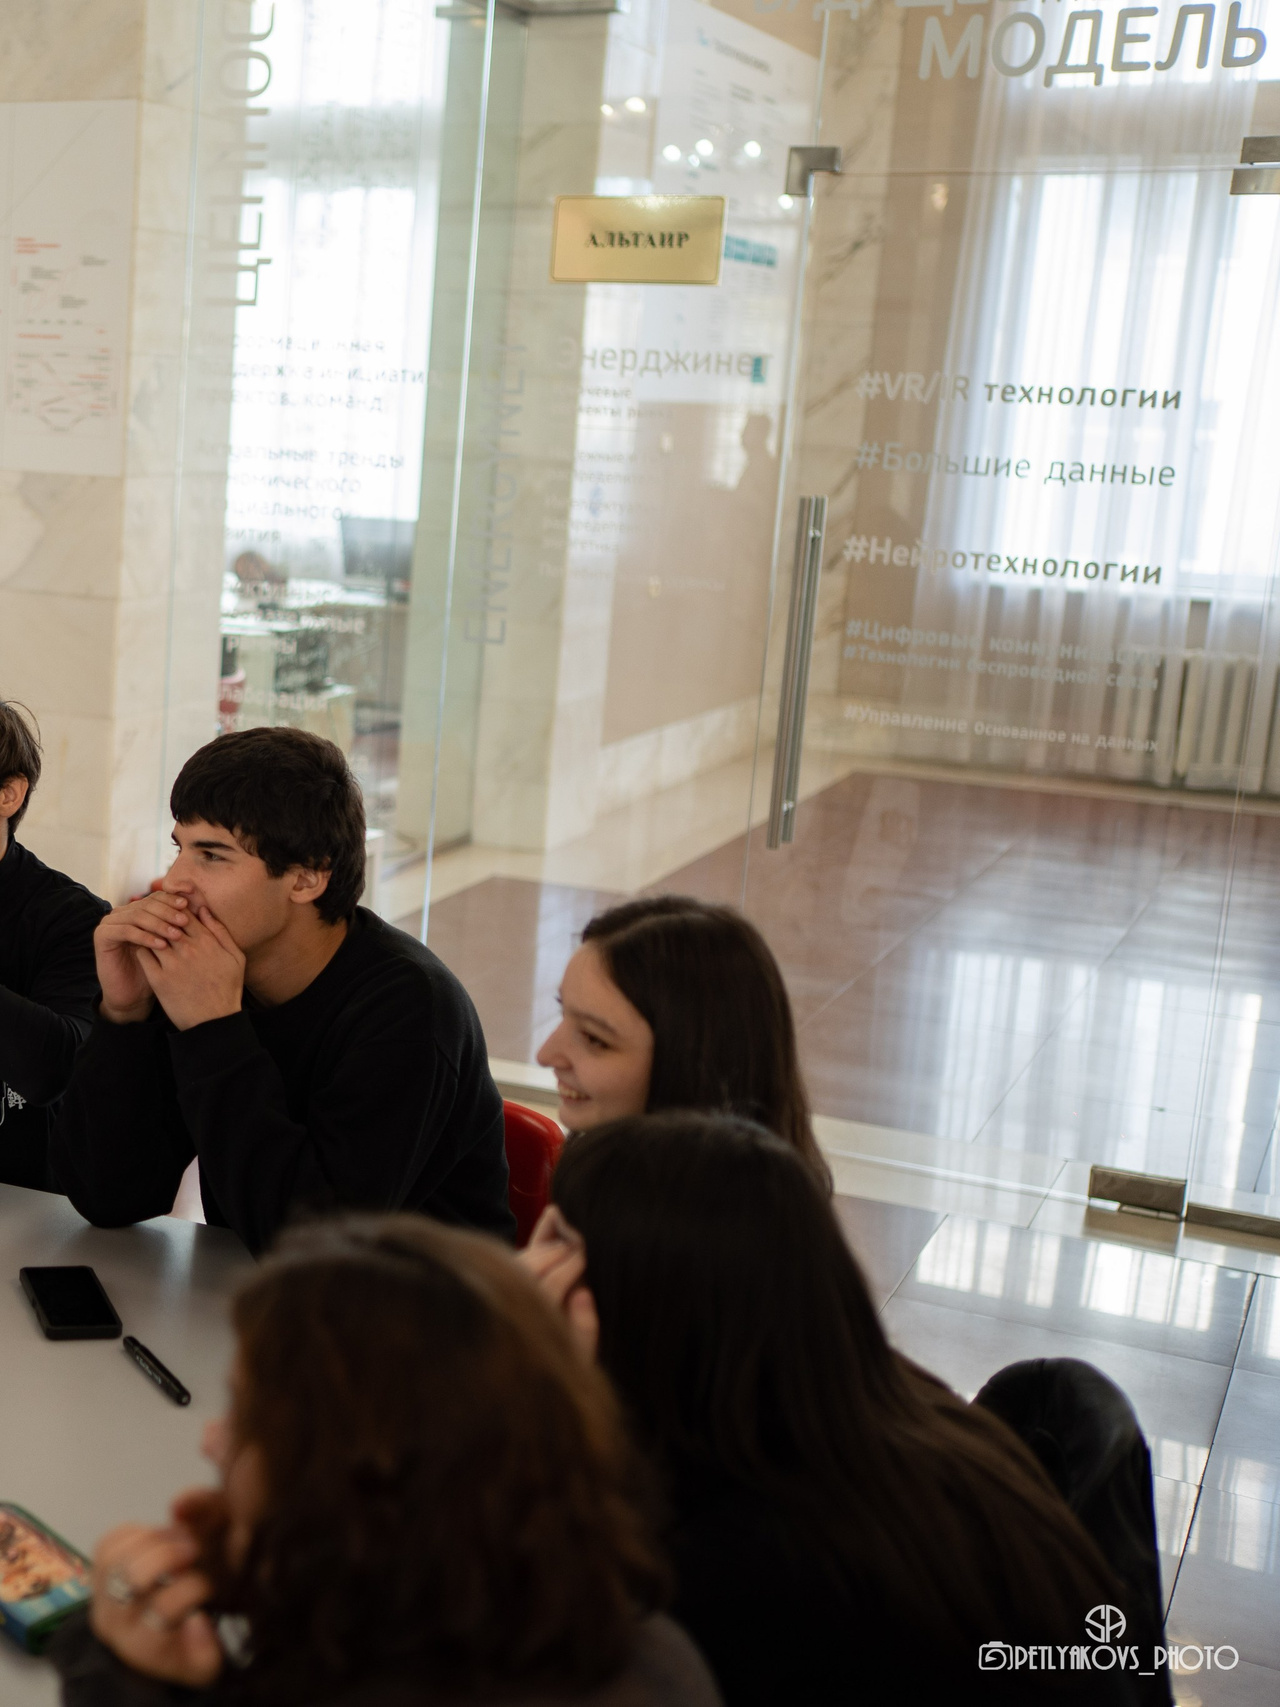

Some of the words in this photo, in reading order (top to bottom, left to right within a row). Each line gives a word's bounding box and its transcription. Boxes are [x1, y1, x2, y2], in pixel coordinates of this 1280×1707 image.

[918, 0, 1268, 88] МОДЕЛЬ
[585, 230, 690, 248] АЛЬТАИР
[983, 382, 1182, 410] технологии
[855, 441, 1031, 480] #Большие
[1043, 460, 1177, 487] данные
[843, 534, 1162, 585] #Нейротехнологии
[1070, 731, 1091, 746] на
